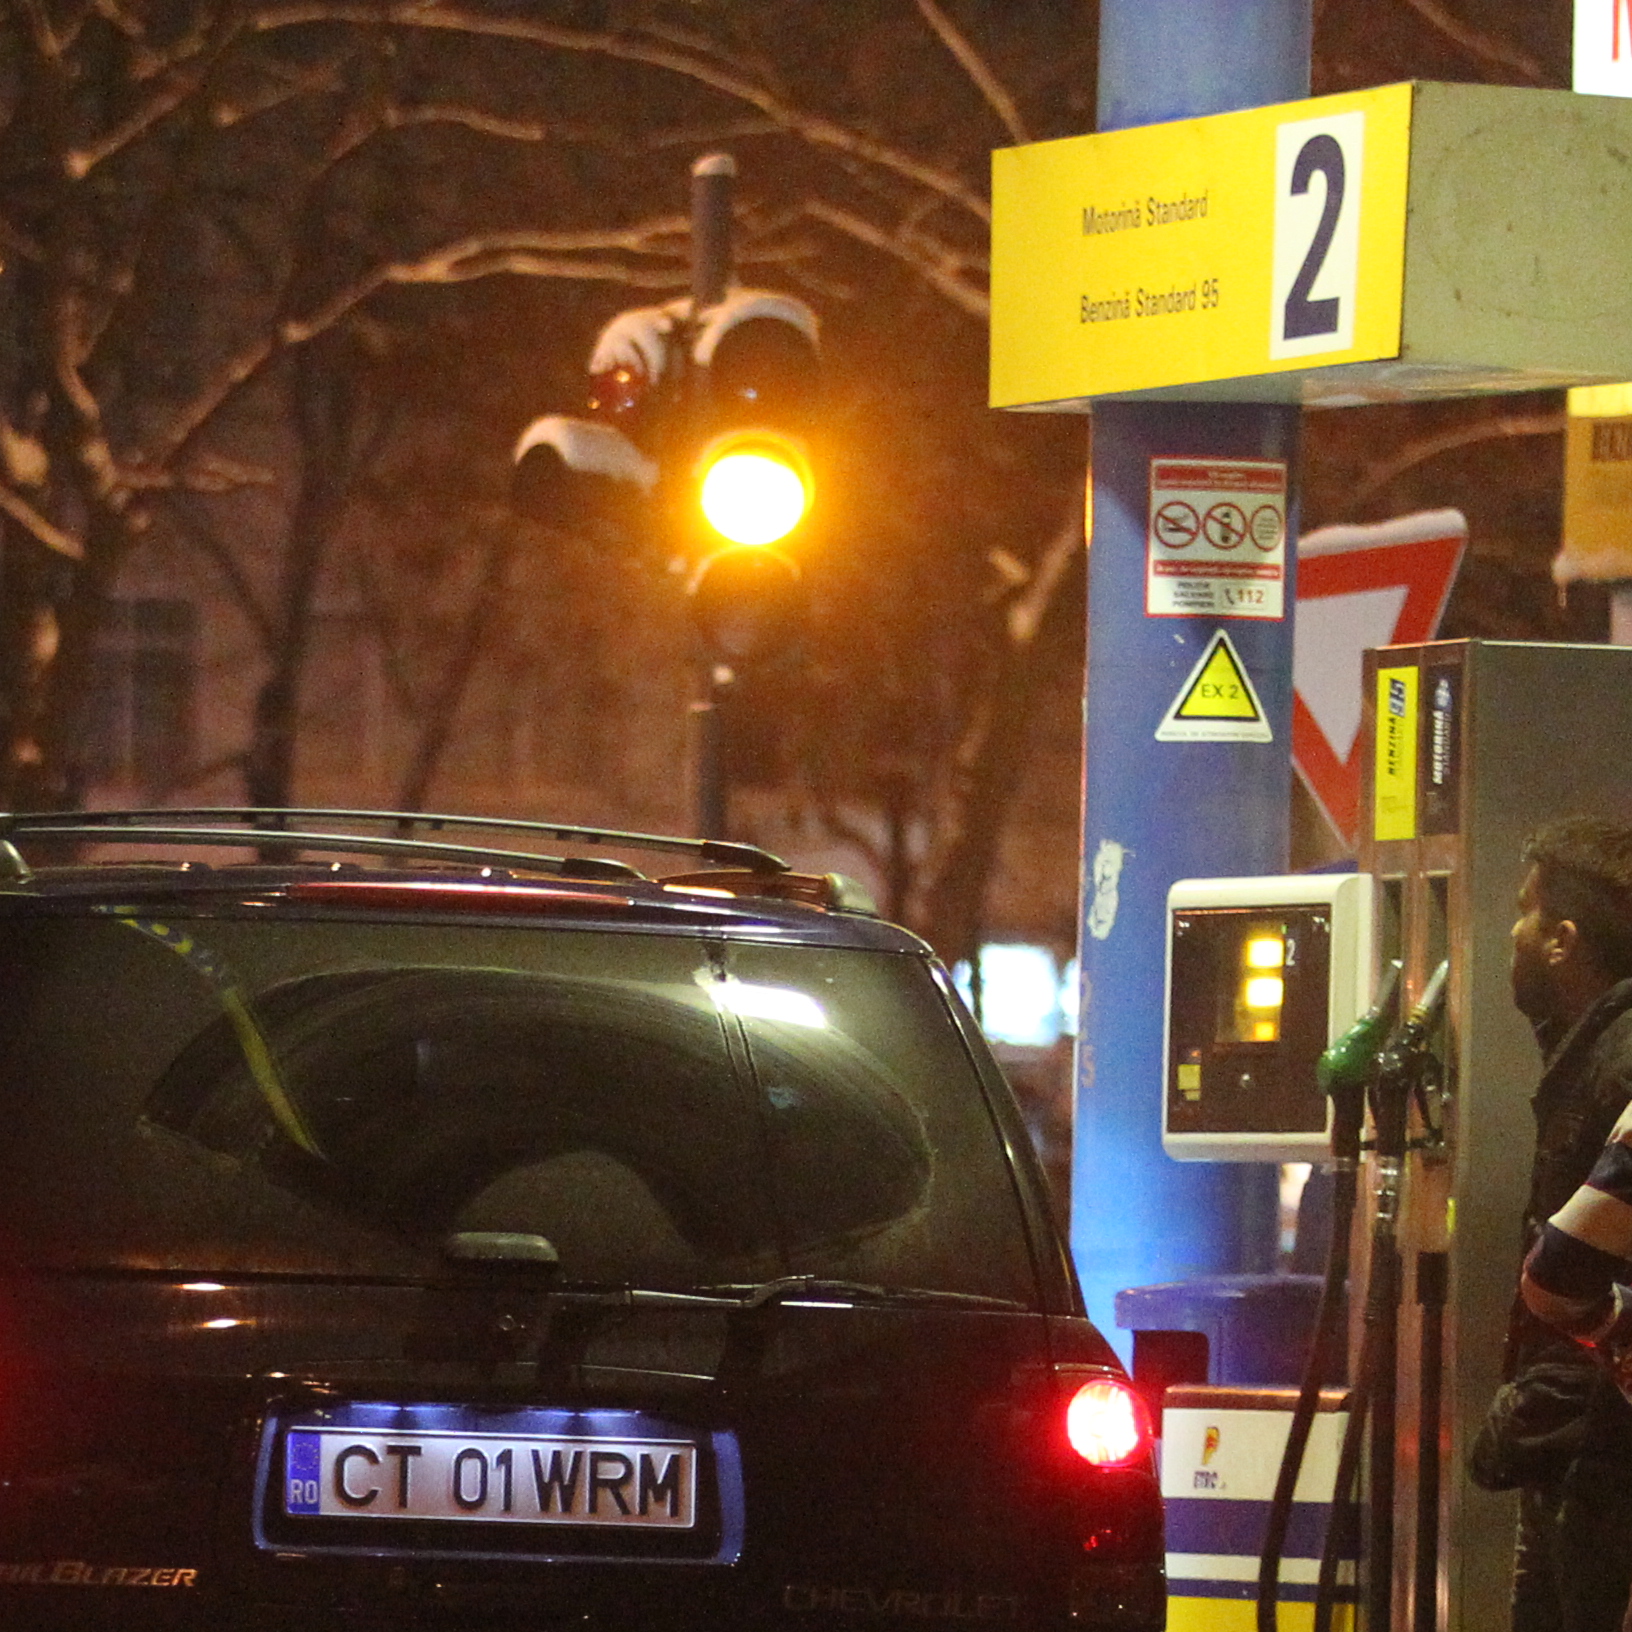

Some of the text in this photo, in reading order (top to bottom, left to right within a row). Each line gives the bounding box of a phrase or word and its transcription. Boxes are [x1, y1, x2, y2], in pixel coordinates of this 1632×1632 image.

[1146, 188, 1209, 227] Standard
[1283, 134, 1346, 341] 2
[1135, 283, 1197, 317] Standard
[1201, 278, 1219, 309] 95
[1237, 588, 1264, 604] 112
[1201, 683, 1240, 699] EX 2
[1286, 938, 1296, 966] 2
[290, 1479, 318, 1504] RO
[334, 1444, 422, 1509] CT
[530, 1448, 682, 1518] WRM
